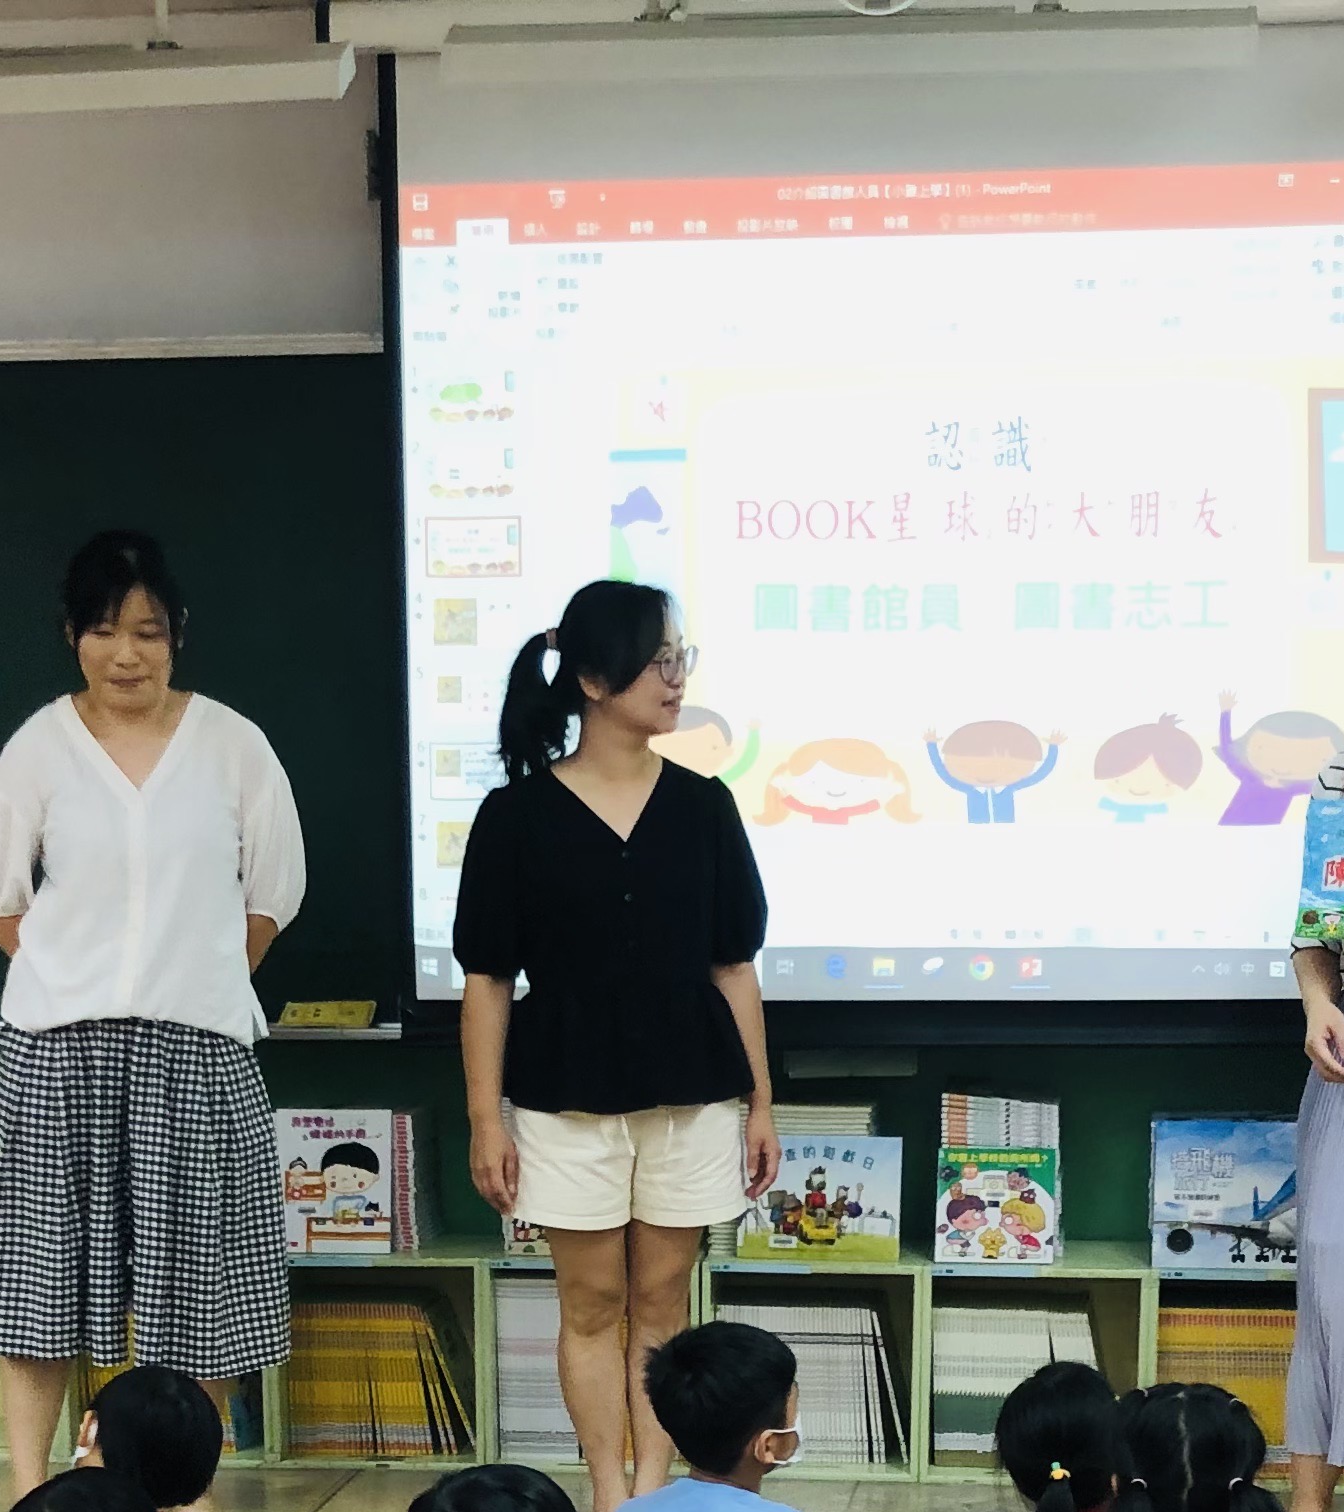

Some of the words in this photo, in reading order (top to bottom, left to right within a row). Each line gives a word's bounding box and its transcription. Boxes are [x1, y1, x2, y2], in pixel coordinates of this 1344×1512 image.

[982, 181, 1051, 194] PowerPoint
[924, 416, 1033, 472] 認識
[735, 489, 1224, 542] BOOK星球的大朋友
[754, 583, 964, 632] 圖書館員
[1013, 580, 1230, 630] 圖書志工
